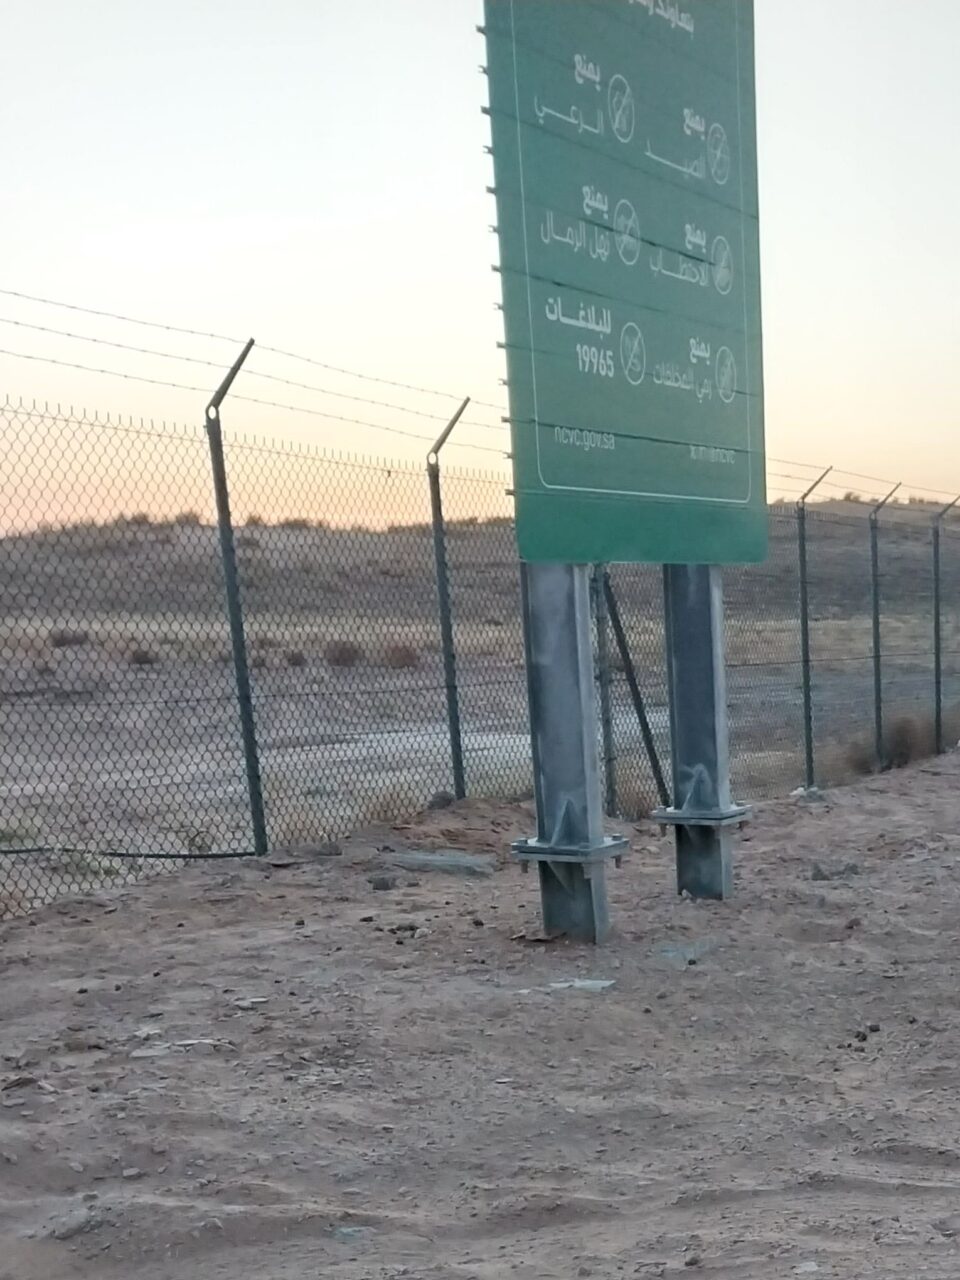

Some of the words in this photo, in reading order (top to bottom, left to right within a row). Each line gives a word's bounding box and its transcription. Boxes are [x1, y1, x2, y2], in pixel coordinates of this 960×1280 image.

[575, 53, 600, 91] يمنع
[683, 107, 705, 140] يمنع
[582, 185, 608, 219] يمنع
[685, 223, 706, 253] يمنع
[576, 343, 614, 377] 19965
[689, 337, 710, 365] يمنع
[554, 426, 615, 451] ncvc.gov.sa
